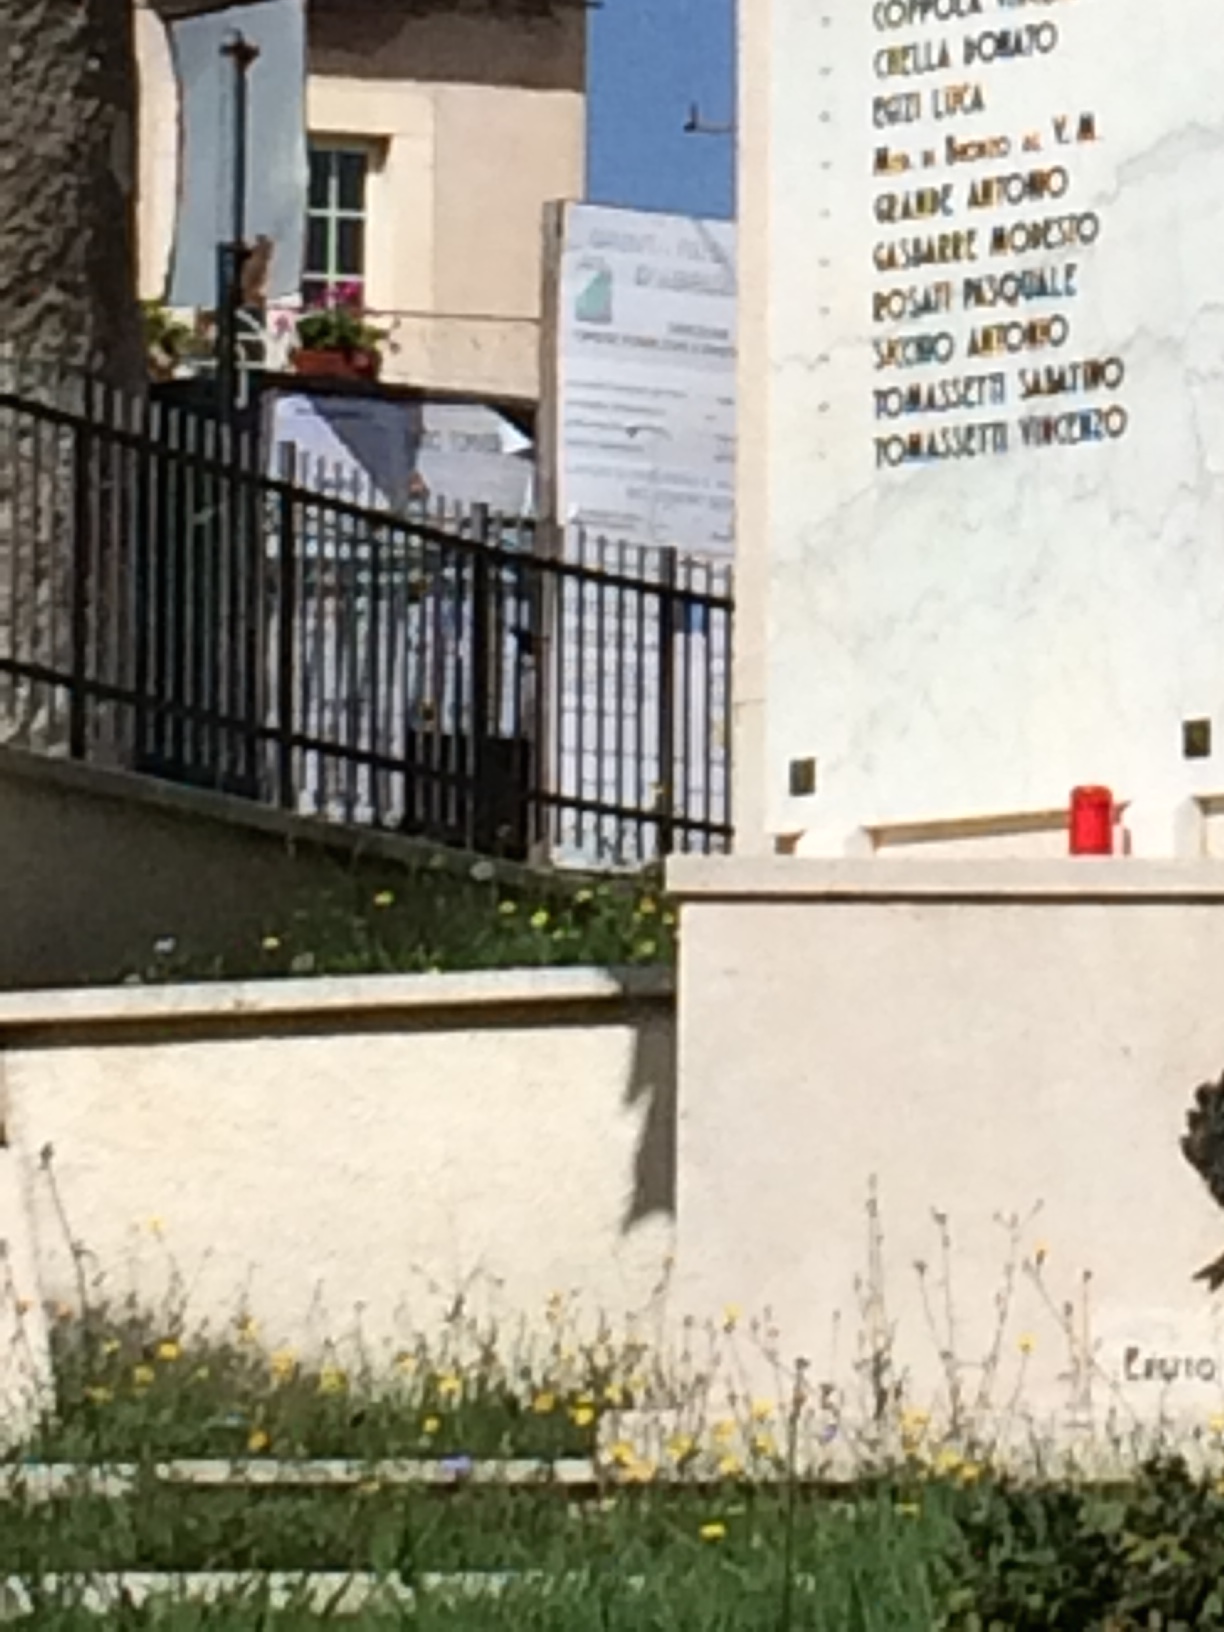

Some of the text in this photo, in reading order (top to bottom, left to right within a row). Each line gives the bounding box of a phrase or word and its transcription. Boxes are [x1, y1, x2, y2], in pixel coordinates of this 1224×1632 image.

[963, 20, 1057, 65] DONATO
[933, 82, 984, 119] LUCA
[873, 165, 1068, 224] GRANDE ANTONIO
[989, 211, 1099, 254] MODESTO
[872, 263, 1076, 322] ROSATI PASQUALE
[967, 313, 1068, 357] ANTONIO
[872, 355, 1124, 419] TOMASSETTI SABATINO
[873, 404, 1127, 468] TOMASSETTI VINCENZO
